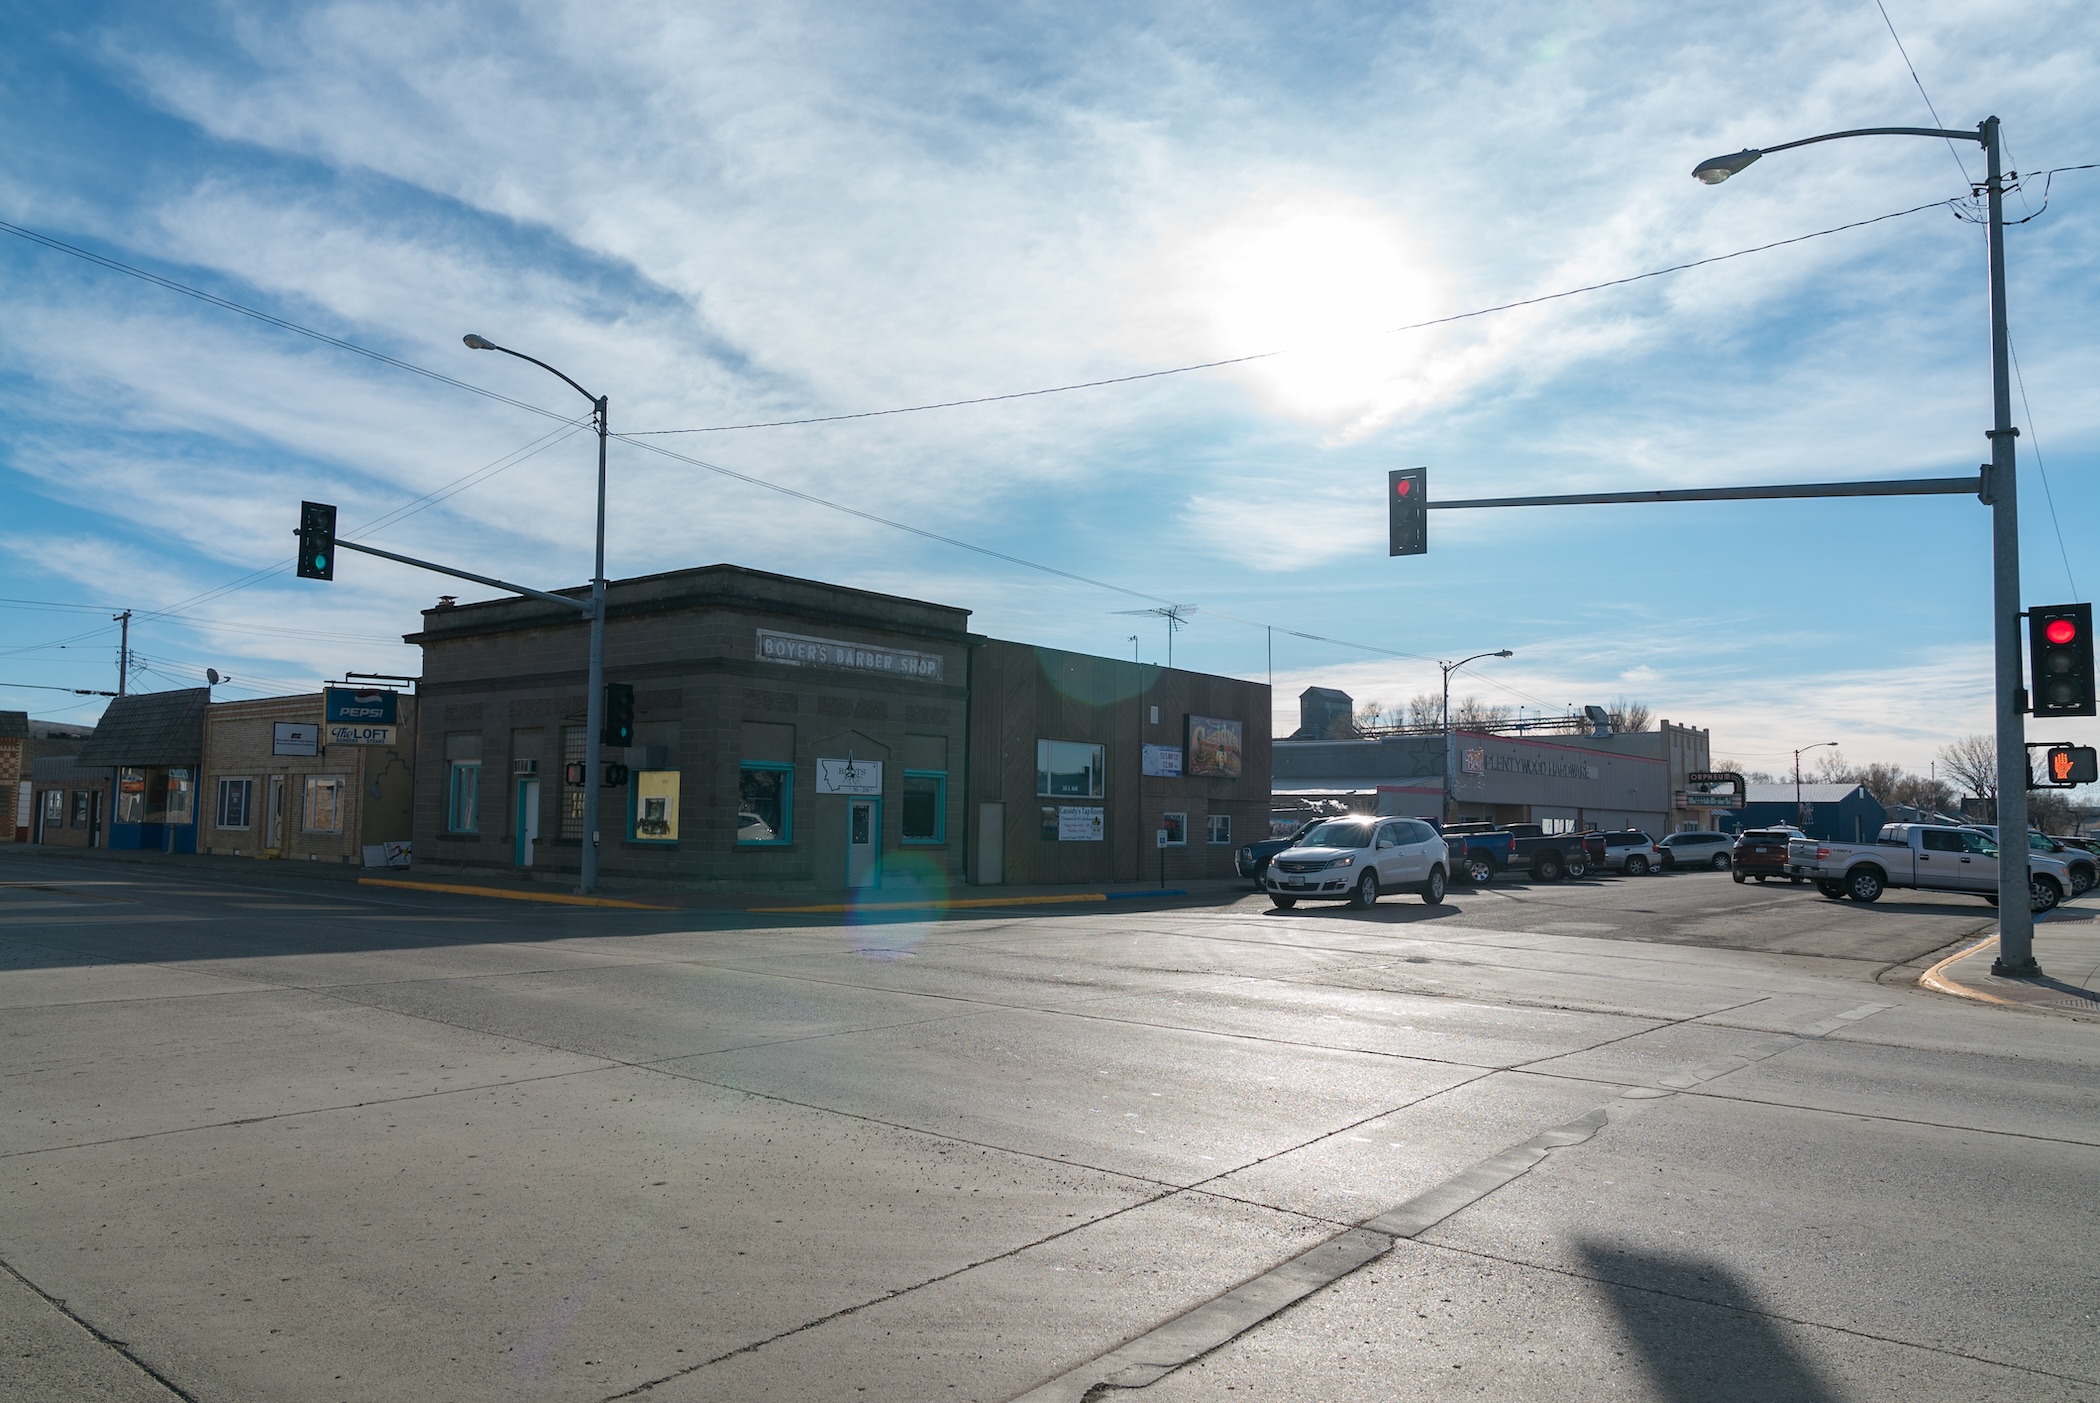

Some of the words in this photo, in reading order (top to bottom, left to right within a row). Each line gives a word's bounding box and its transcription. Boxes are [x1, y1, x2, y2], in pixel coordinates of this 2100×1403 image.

[764, 638, 828, 662] BOYER'S
[836, 649, 893, 669] BARBER
[900, 658, 937, 675] SHOP
[339, 707, 384, 718] PEPSI
[332, 727, 353, 738] The
[354, 728, 389, 739] LOFT
[1486, 755, 1546, 775] PLENTYWOOD
[1549, 763, 1590, 779] HARDWARE
[1690, 773, 1731, 781] ORPHEUM
